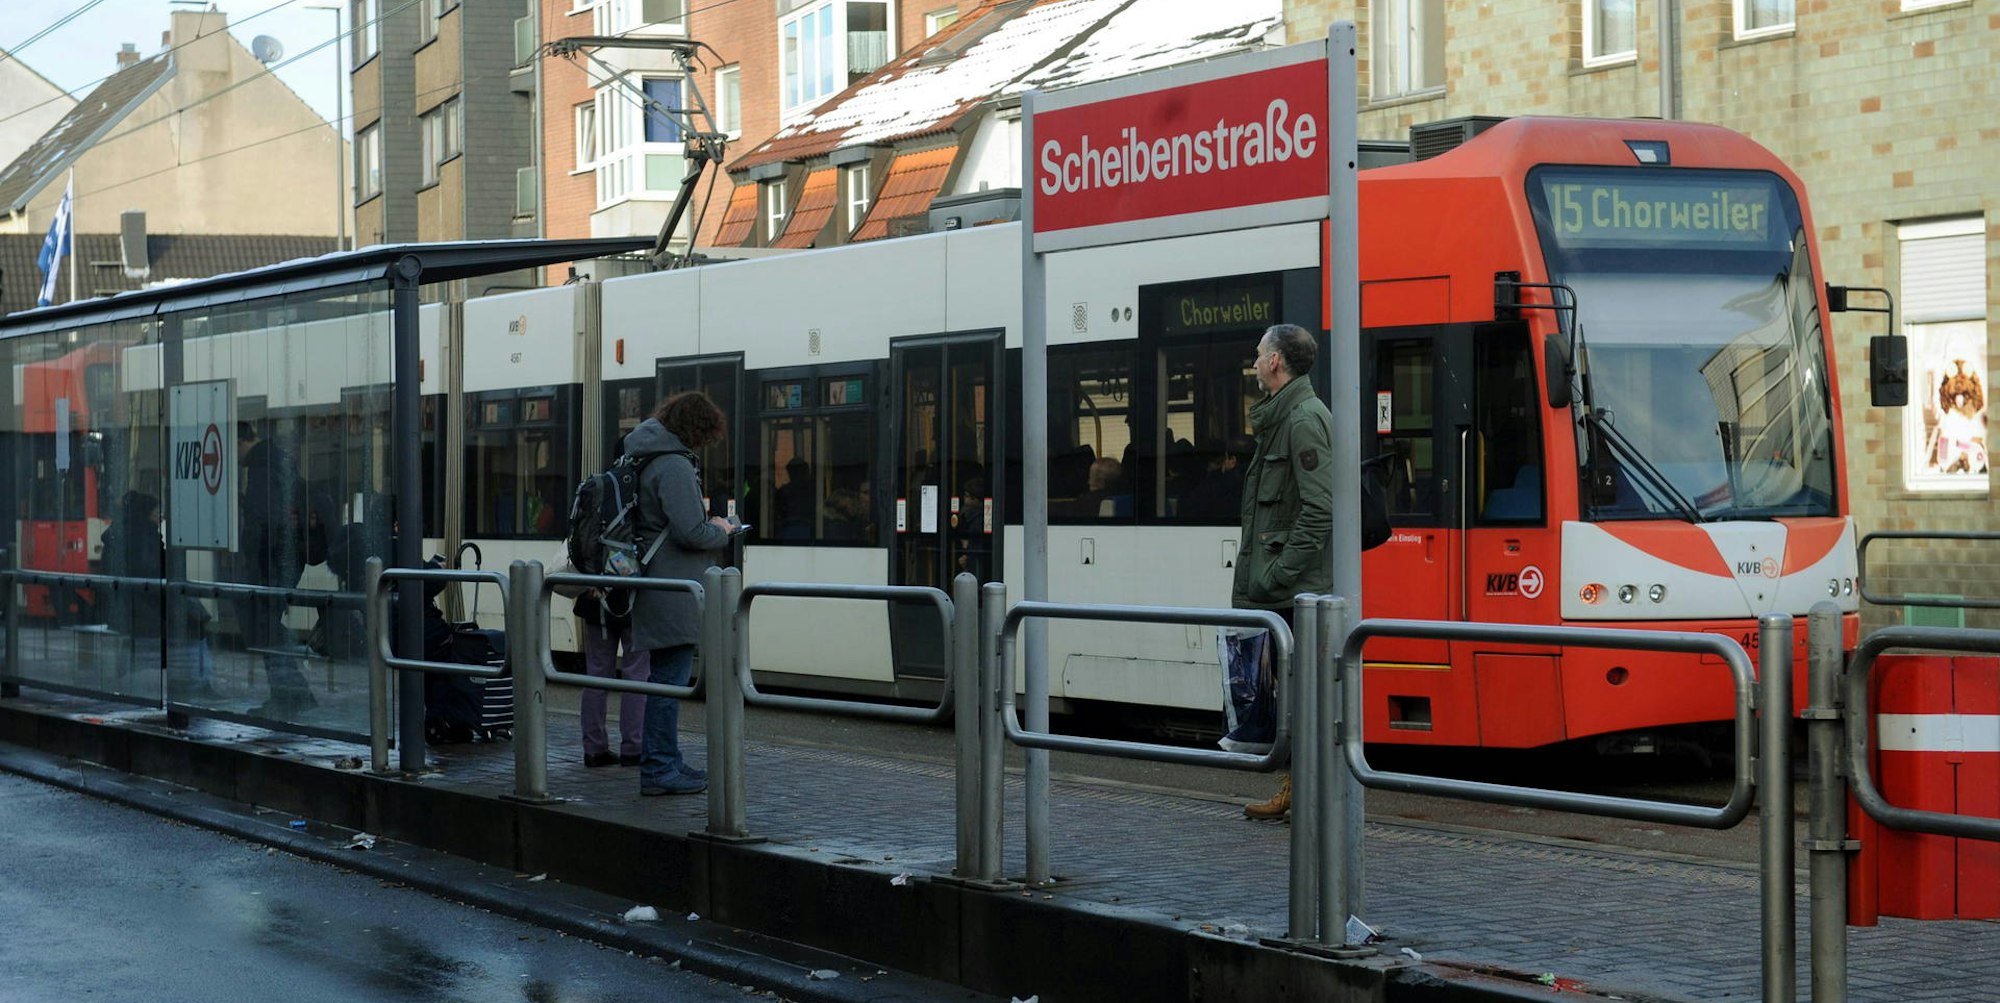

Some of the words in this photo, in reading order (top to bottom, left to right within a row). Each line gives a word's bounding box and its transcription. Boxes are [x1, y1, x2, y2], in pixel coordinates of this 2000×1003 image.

[1040, 98, 1317, 196] Scheibenstraße
[1551, 184, 1583, 233] 15
[1592, 188, 1765, 231] Chorweiler
[1181, 293, 1270, 325] Chorweiler
[509, 320, 519, 332] KVB
[175, 441, 201, 480] KVB
[1737, 561, 1761, 574] KVB
[1486, 574, 1518, 593] KVB
[1741, 632, 1760, 649] 45
